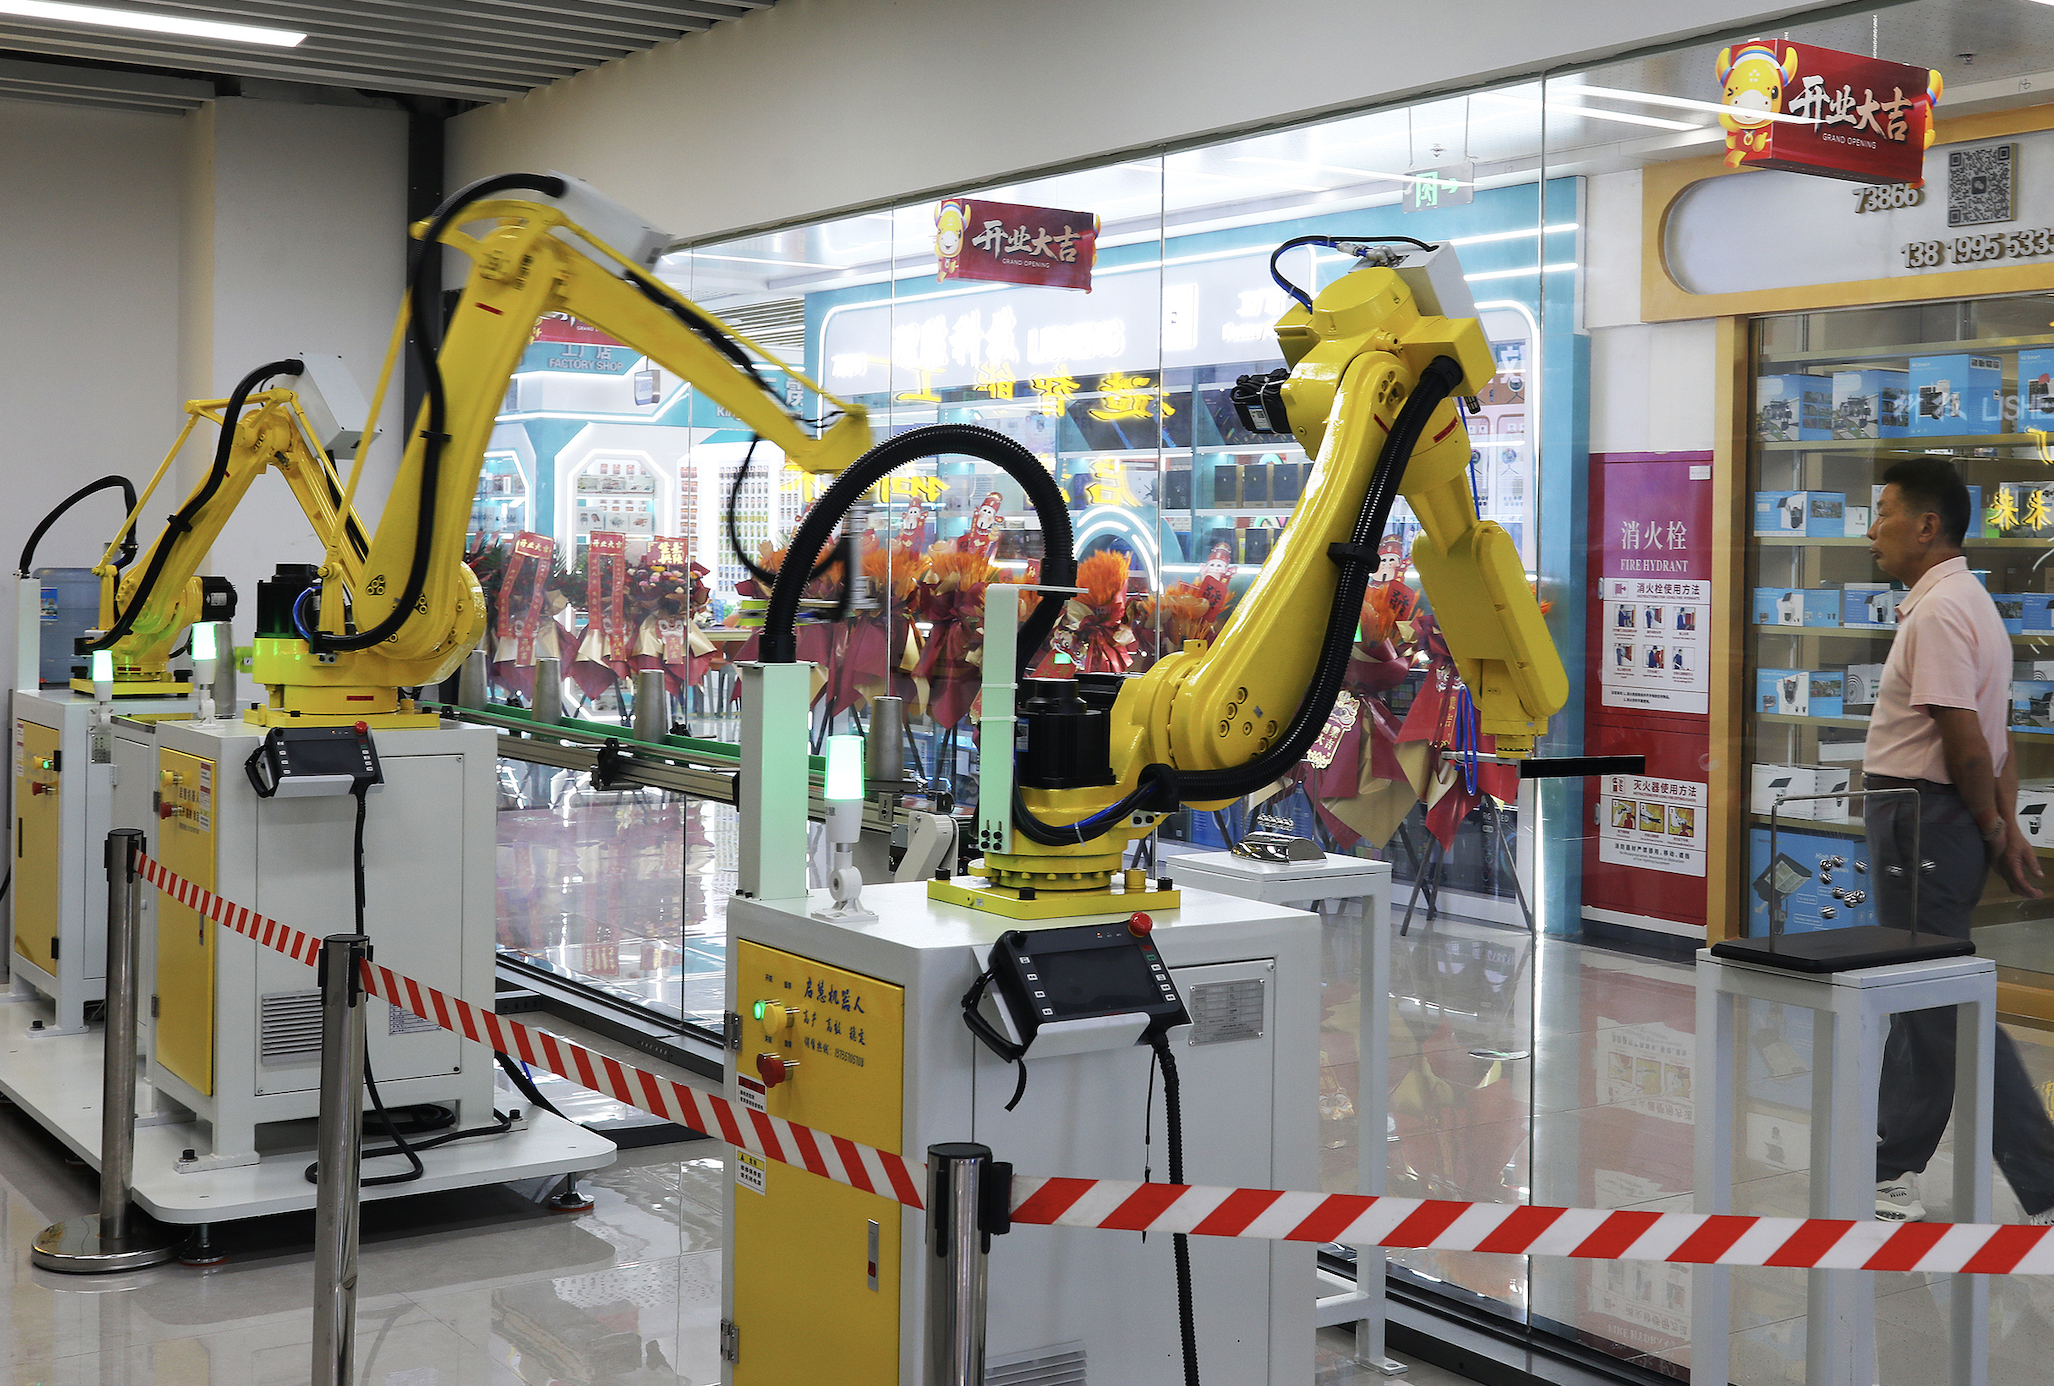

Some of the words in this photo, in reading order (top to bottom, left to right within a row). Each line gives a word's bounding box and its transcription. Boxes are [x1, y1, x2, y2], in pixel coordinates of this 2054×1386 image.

[1788, 75, 1913, 142] 开业大吉
[1821, 132, 1847, 145] GRAND
[1847, 136, 1877, 150] OPENING
[971, 219, 1082, 263] 开业大吉
[1901, 240, 1940, 268] 138
[1947, 233, 2002, 264] 1995
[1002, 257, 1023, 266] GRAND
[1023, 259, 1051, 269] OPENING
[548, 358, 595, 371] FACTORY
[595, 360, 623, 372] SHOP
[1621, 520, 1688, 551] 消火栓
[1620, 558, 1642, 571] FIRE
[1643, 559, 1689, 573] HYDRANT
[1636, 582, 1701, 596] 消火栓使用方法
[1633, 779, 1697, 798] 灭火器使用方法
